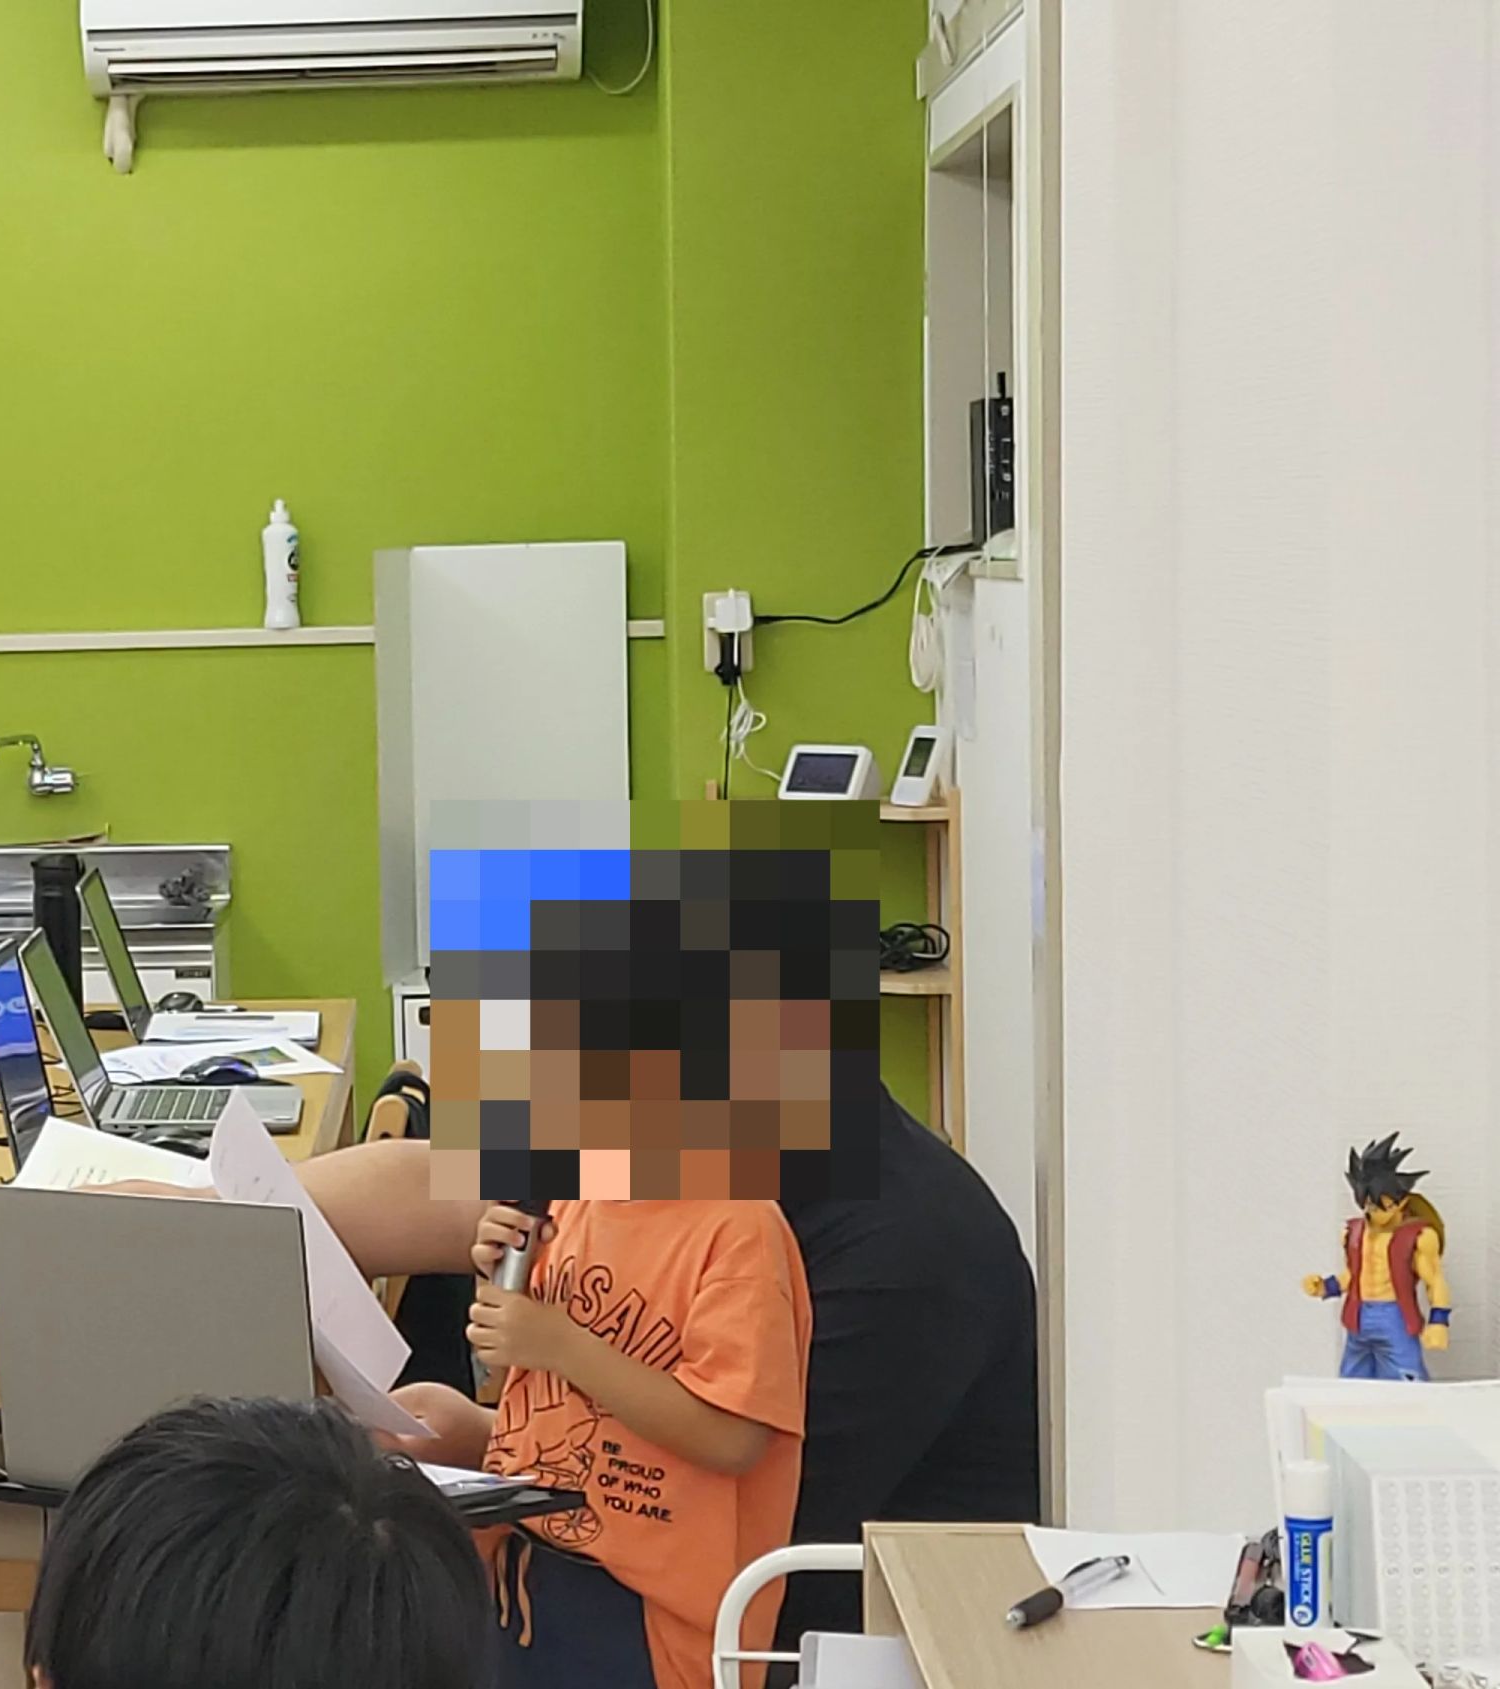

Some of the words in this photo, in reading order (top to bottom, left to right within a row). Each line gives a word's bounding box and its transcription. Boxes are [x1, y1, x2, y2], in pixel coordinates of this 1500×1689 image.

[602, 1440, 621, 1455] BE
[609, 1458, 665, 1481] PROUD
[598, 1474, 619, 1488] OF
[624, 1480, 661, 1500] WHO
[604, 1494, 633, 1513] YOU
[636, 1503, 672, 1523] ARE
